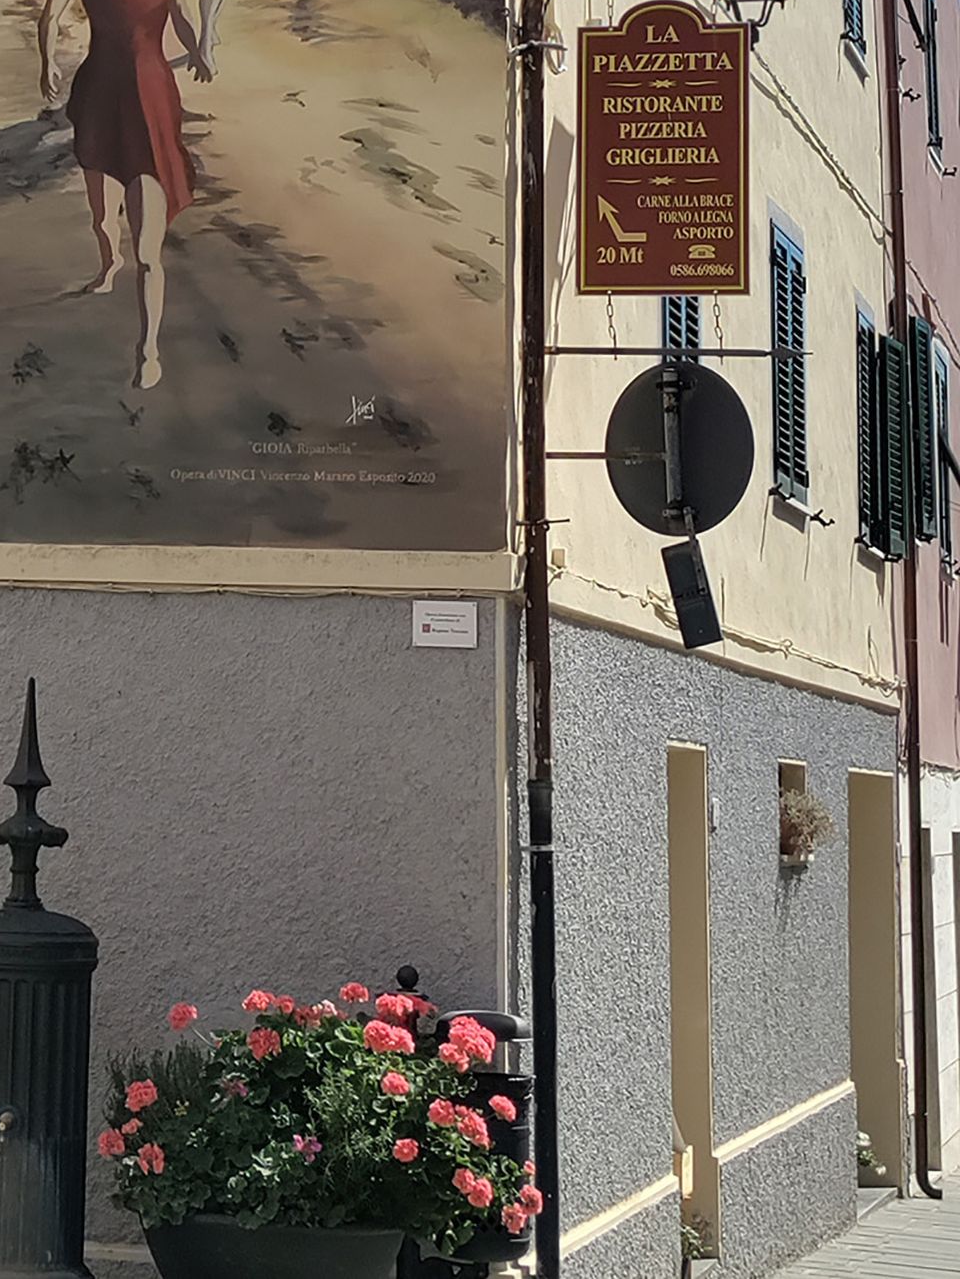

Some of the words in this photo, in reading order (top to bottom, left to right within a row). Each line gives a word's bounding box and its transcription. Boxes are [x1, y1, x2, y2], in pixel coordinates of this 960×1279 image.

[645, 25, 680, 43] LA
[593, 52, 733, 73] PIAZZETTA
[603, 95, 723, 114] RISTORANTE
[619, 122, 707, 139] PIZZERIA
[606, 147, 720, 165] GRIGLIERIA
[637, 195, 671, 208] CARNE
[672, 195, 698, 207] ALLA
[700, 194, 734, 207] BRACE
[659, 211, 692, 223] FORNO
[692, 211, 700, 223] A
[700, 210, 733, 223] LEGNA
[673, 227, 734, 239] ASPORTO
[597, 247, 616, 263] 20
[619, 247, 644, 263] Mt
[670, 264, 734, 276] 0586.698066
[170, 468, 206, 482] Opera
[218, 469, 255, 480] VINCI
[407, 472, 436, 483] 2020
